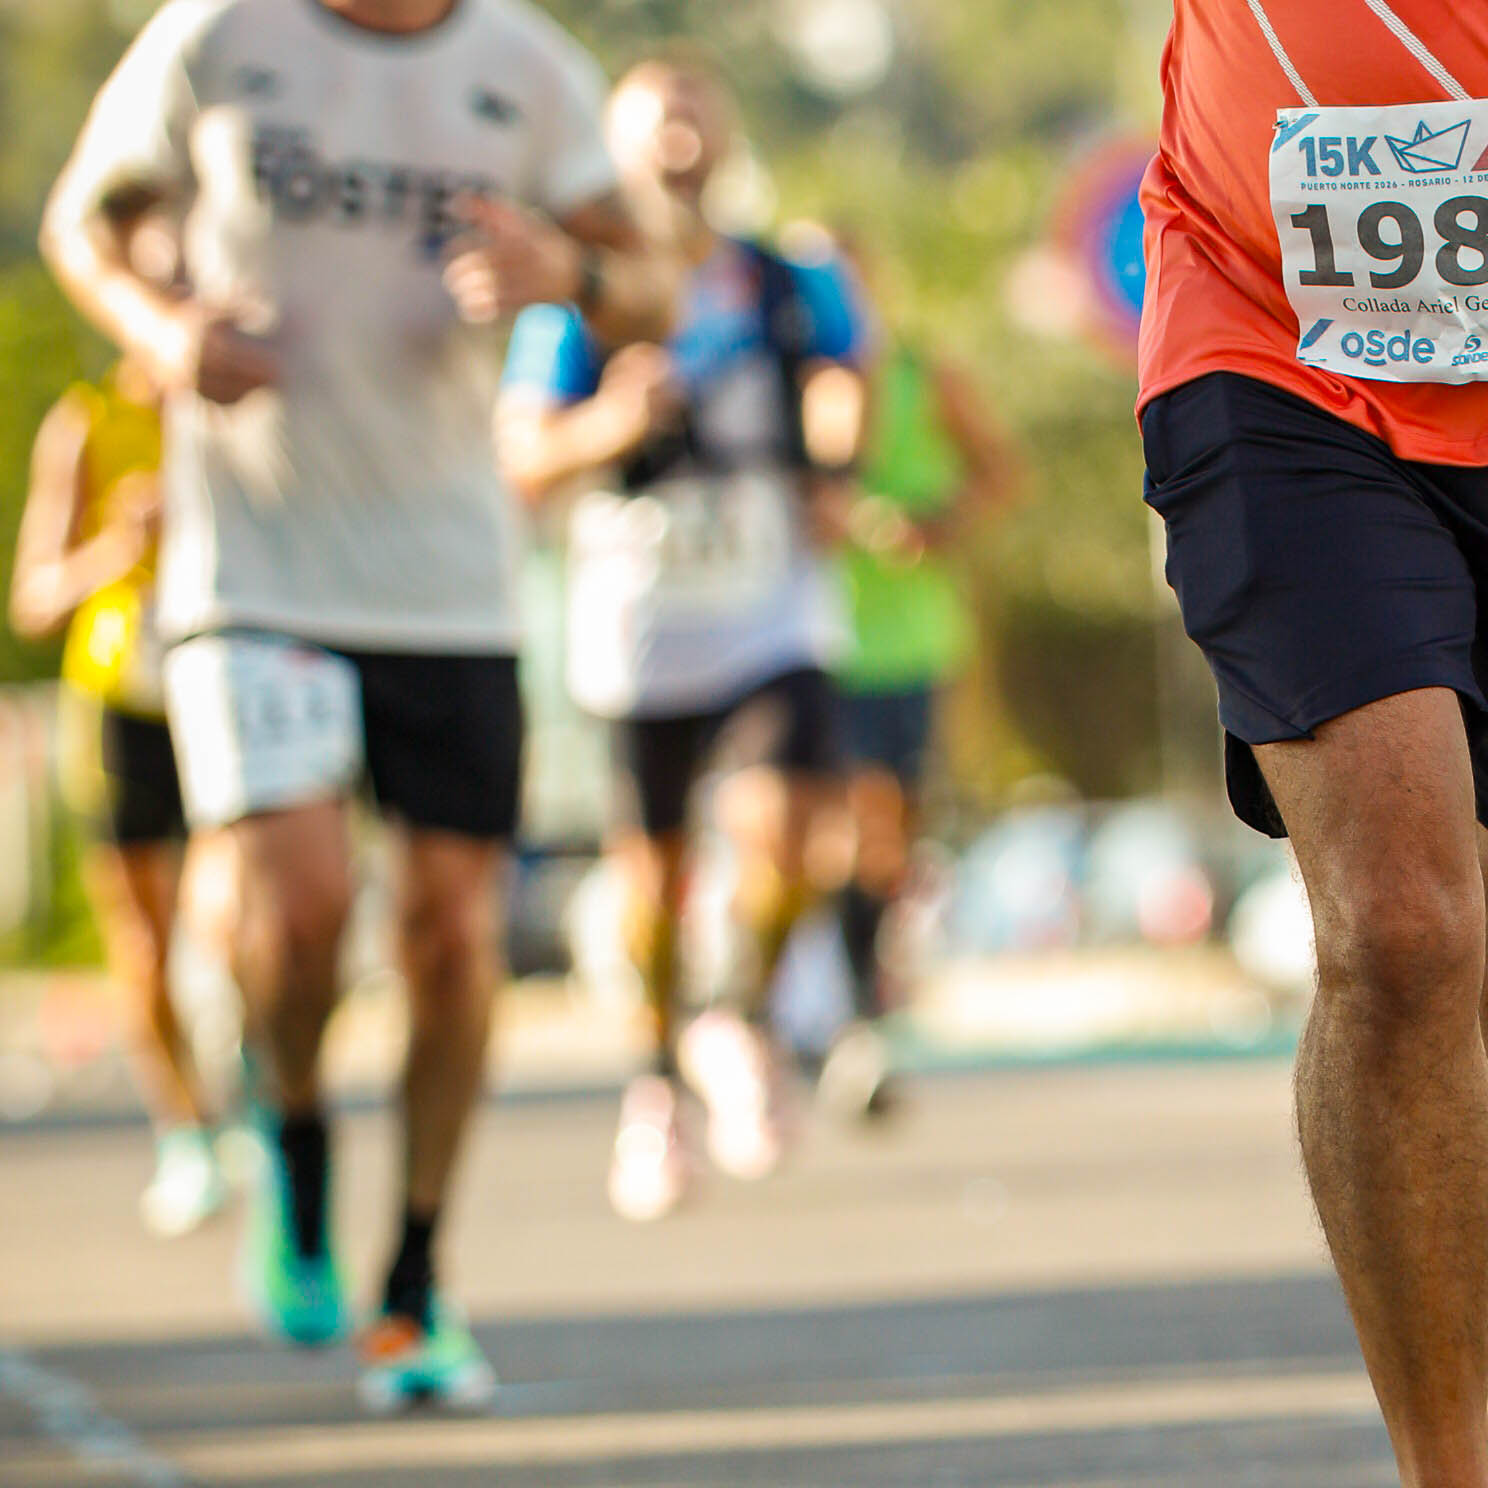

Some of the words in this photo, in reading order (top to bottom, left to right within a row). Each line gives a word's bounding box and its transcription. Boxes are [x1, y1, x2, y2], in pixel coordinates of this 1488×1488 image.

[1298, 136, 1382, 177] 15K
[1300, 181, 1337, 191] PUERTO
[1340, 181, 1371, 190] NORTE
[1374, 180, 1398, 189] 2026
[1408, 177, 1451, 187] ROSARIO
[1463, 175, 1473, 183] 12
[1477, 174, 1488, 182] DE
[1342, 297, 1411, 313] Collada
[1417, 295, 1460, 314] Ariel
[1340, 329, 1435, 365] osde
